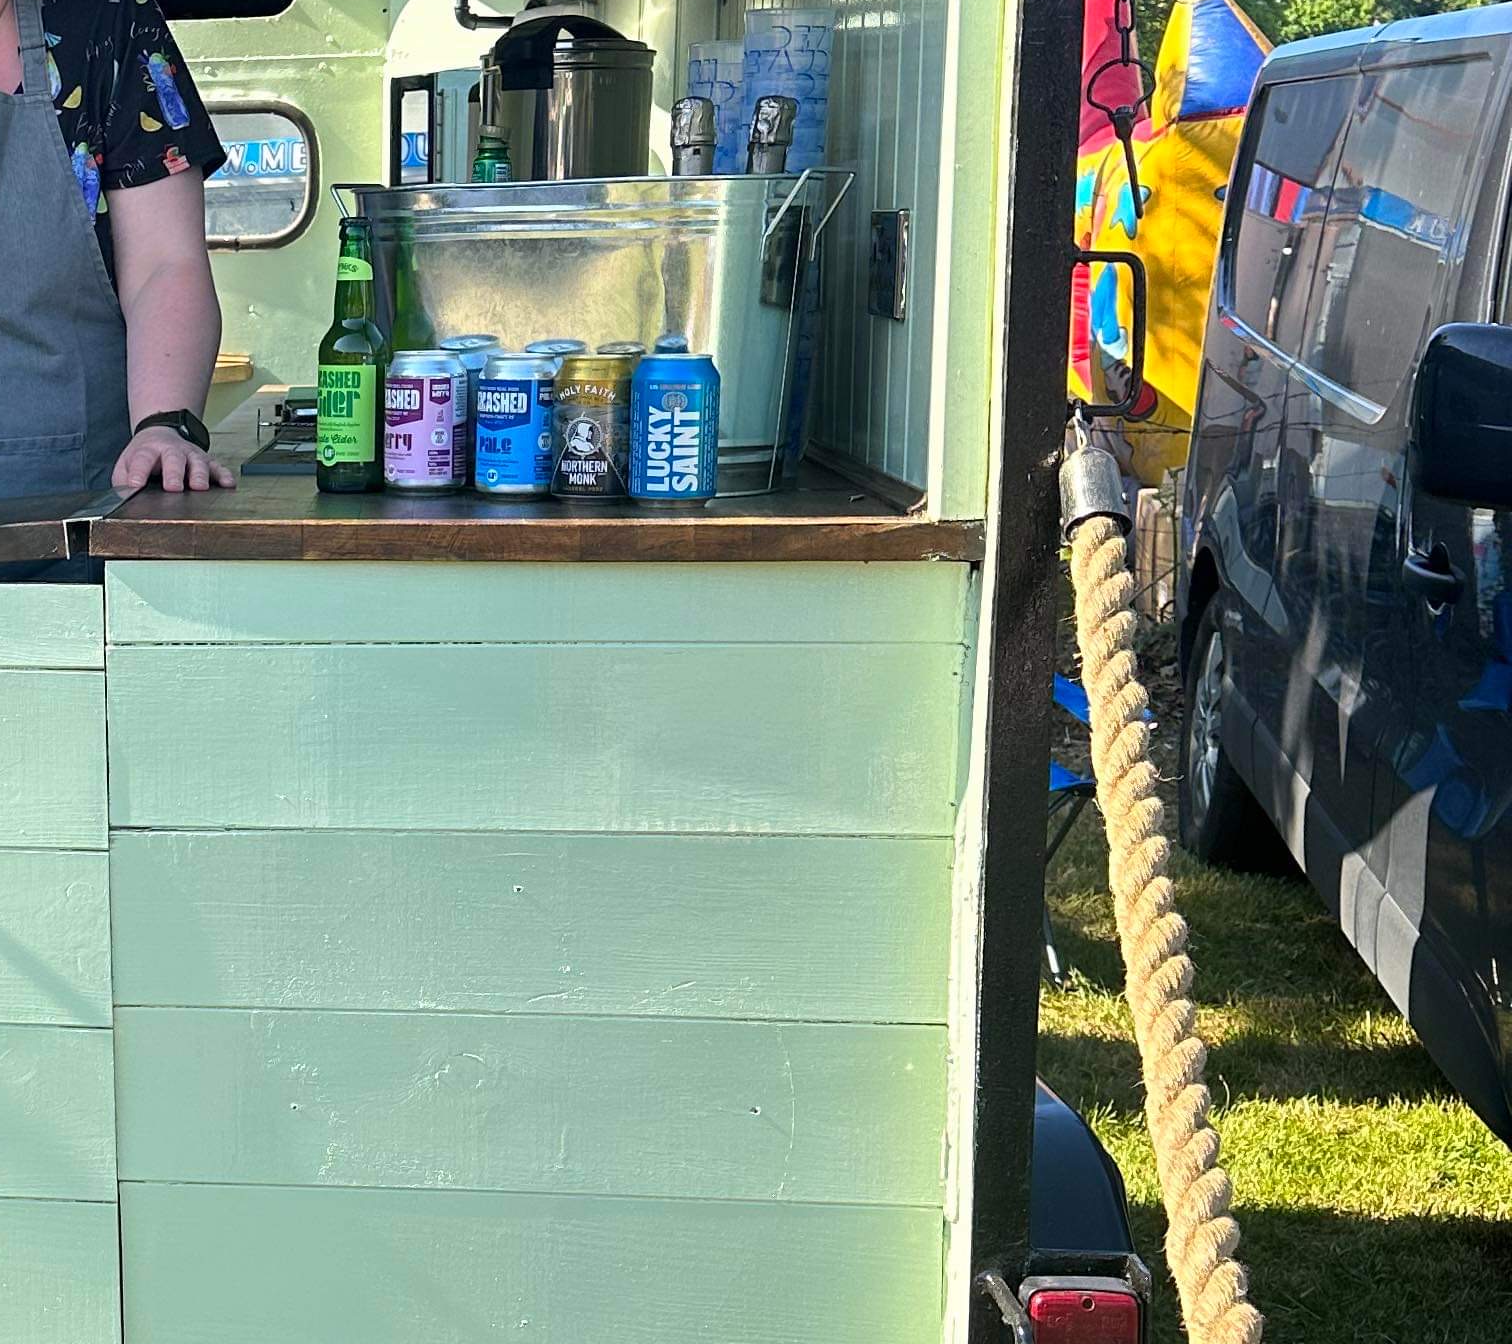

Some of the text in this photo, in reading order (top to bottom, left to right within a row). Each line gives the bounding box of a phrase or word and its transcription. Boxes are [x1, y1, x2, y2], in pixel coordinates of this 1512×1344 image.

[385, 388, 421, 411] ASHED
[559, 384, 582, 401] HOLY
[584, 384, 617, 402] FAITH
[646, 406, 672, 492] LUCKY
[671, 406, 700, 492] SAINT
[561, 459, 609, 473] NORTHERN
[568, 473, 598, 486] MONK
